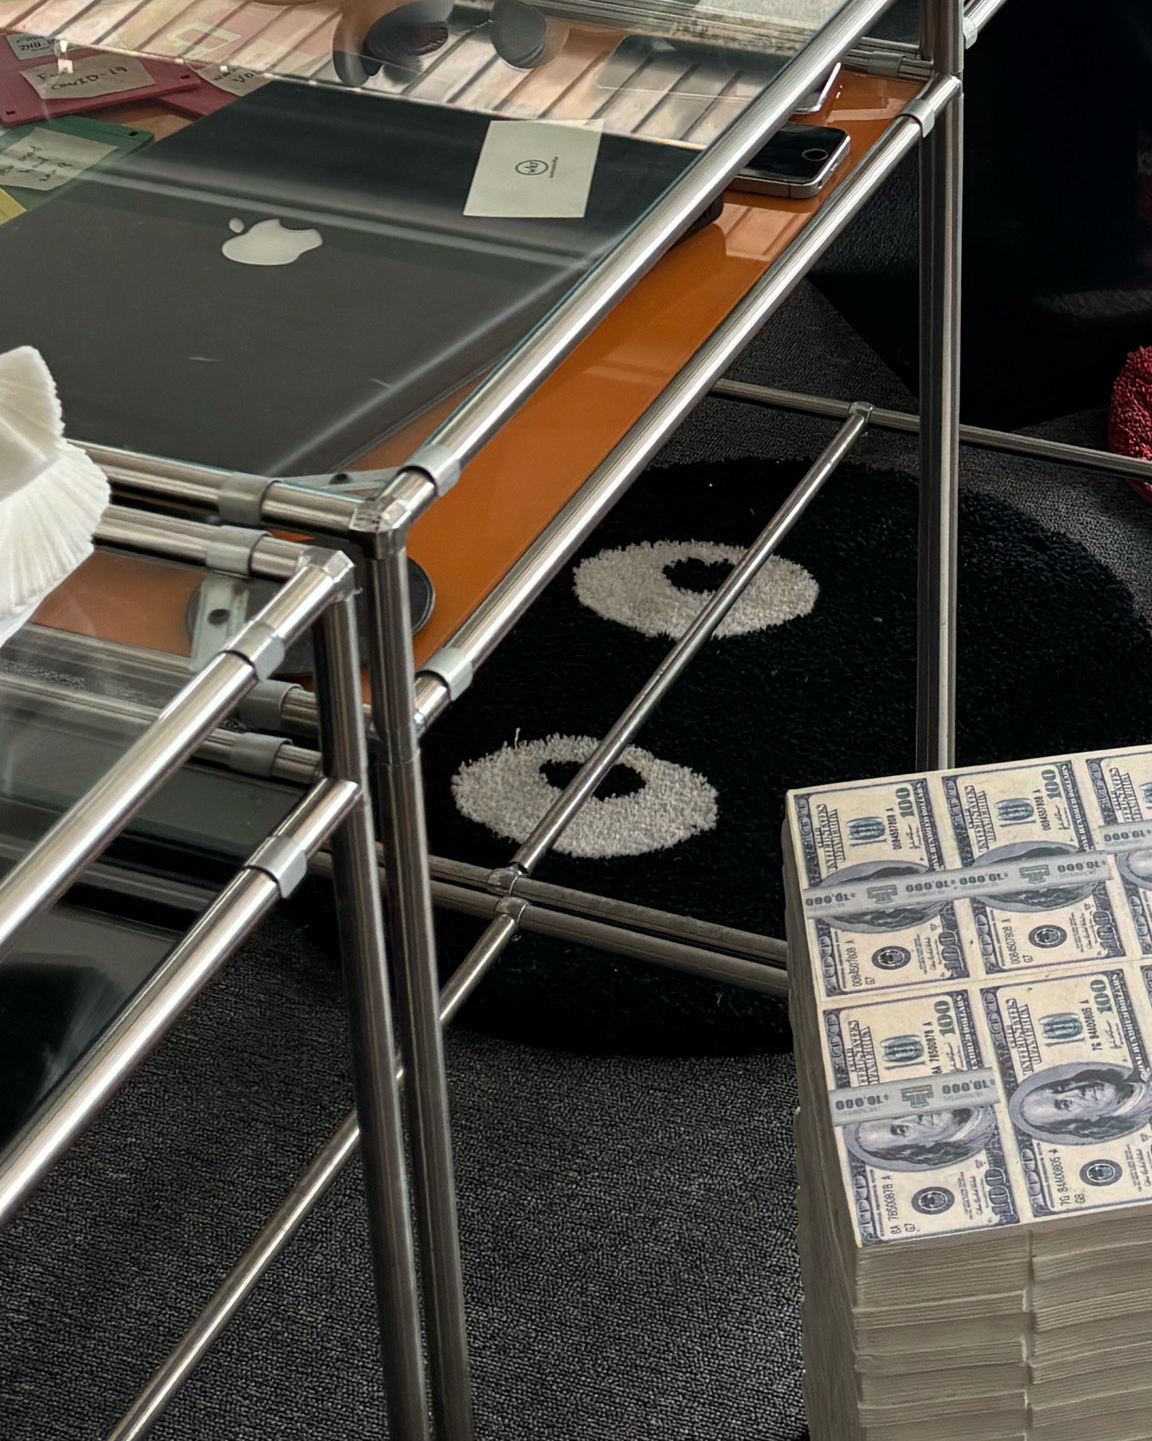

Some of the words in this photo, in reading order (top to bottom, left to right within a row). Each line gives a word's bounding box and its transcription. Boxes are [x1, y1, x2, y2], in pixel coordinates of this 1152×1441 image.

[894, 786, 915, 818] 100
[1040, 768, 1062, 800] 100
[1090, 909, 1119, 949] 100
[936, 929, 963, 971] 100
[1089, 978, 1114, 1014] 100
[932, 999, 956, 1036] 100
[982, 1166, 1012, 1216] 100
